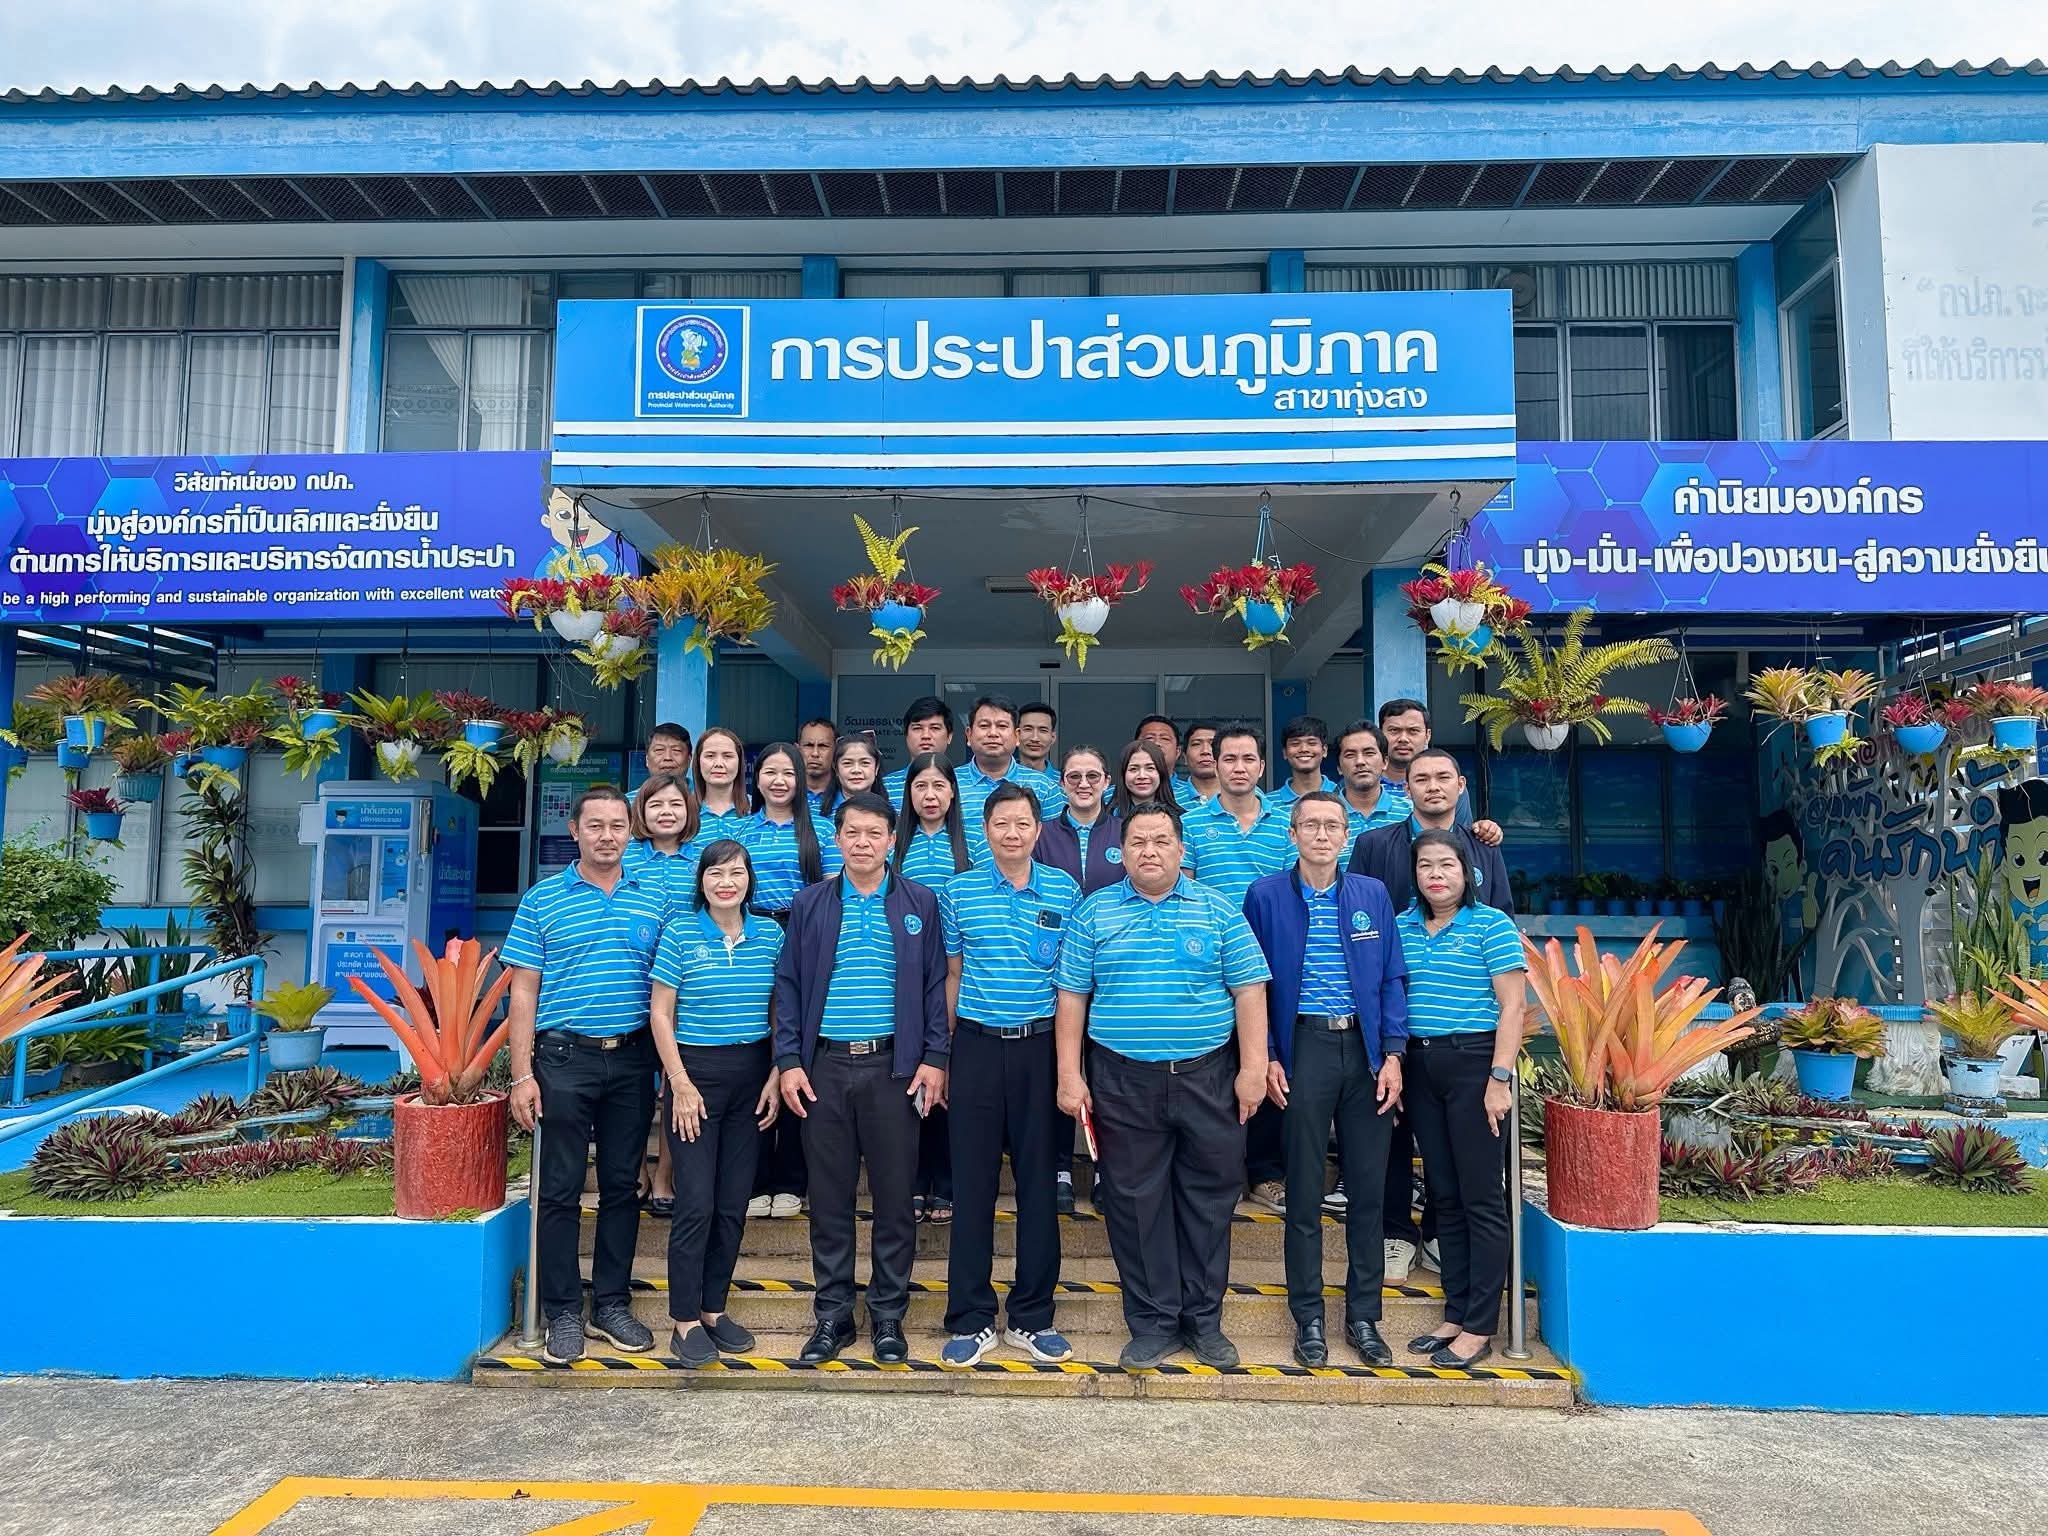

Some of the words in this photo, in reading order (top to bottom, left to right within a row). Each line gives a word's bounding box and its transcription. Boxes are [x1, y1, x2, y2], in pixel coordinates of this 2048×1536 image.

[770, 315, 1438, 394] การประปาส่วนภูมิภาค
[648, 389, 735, 402] การประปาส่วนภูมิภาค
[708, 402, 734, 410] Authority
[1274, 384, 1429, 414] สาขาทุ่งสง
[174, 471, 297, 492] วิสัยทัศน์ของ
[306, 472, 354, 490] กปภ.
[1675, 478, 1924, 514] ค่านิยมองค์กร
[87, 502, 439, 542] มุ่งสู่องค์กรที่เป็นเลิศและยั่งยืน
[10, 538, 515, 573] ด้านการให้บริการและบริหารจัดการน้ำประปา
[3, 592, 20, 605] be
[26, 595, 35, 605] a
[40, 591, 69, 607] high
[75, 590, 151, 607] performing
[156, 590, 182, 603] and
[188, 589, 268, 603] sustainable
[273, 588, 360, 604] organization
[365, 587, 395, 601] with
[400, 587, 464, 600] excellent
[469, 587, 513, 601] wate
